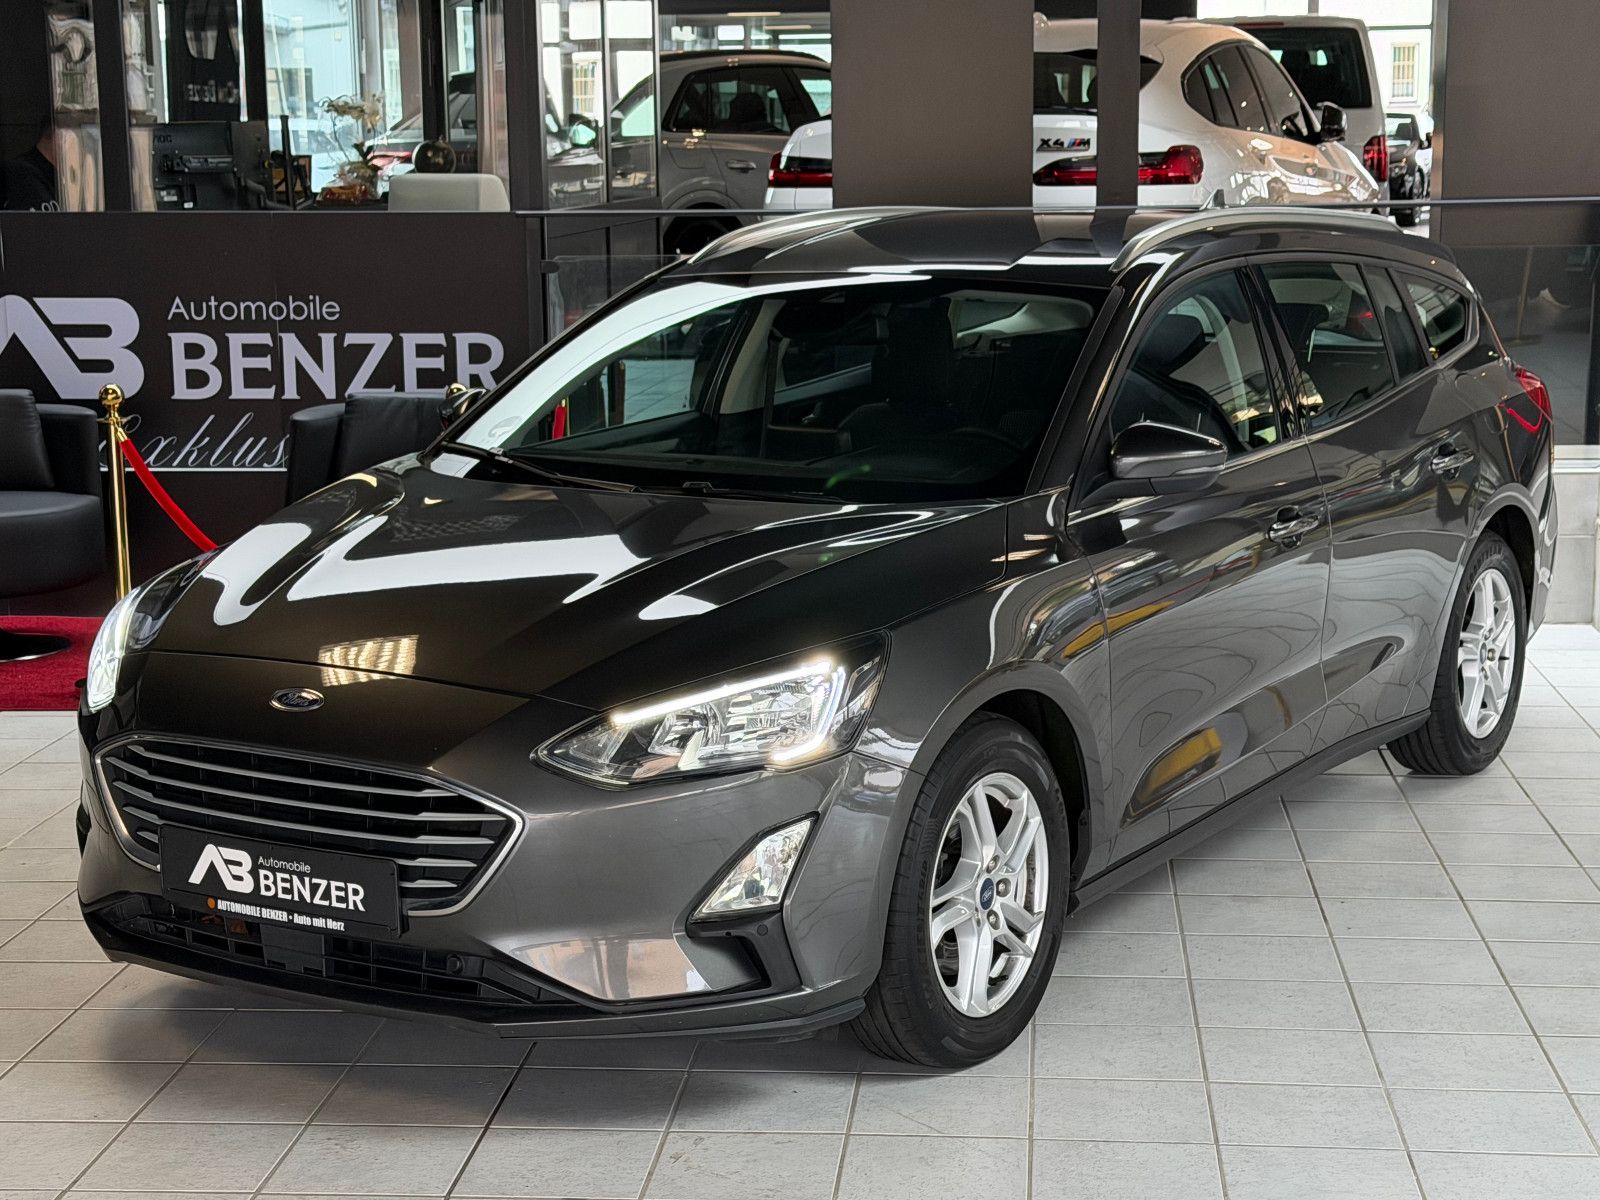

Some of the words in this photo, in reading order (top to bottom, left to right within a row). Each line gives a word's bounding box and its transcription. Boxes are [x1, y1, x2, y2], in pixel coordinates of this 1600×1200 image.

[167, 295, 341, 321] Automobile
[167, 332, 505, 400] BENZER
[188, 844, 254, 894] AB
[258, 856, 311, 873] Automobile
[258, 869, 366, 912] BENZER
[217, 899, 261, 918] AUTOMOBILE
[261, 907, 288, 922] BENZER
[293, 913, 312, 926] Auto
[312, 917, 326, 928] mit
[327, 918, 345, 931] Herz
